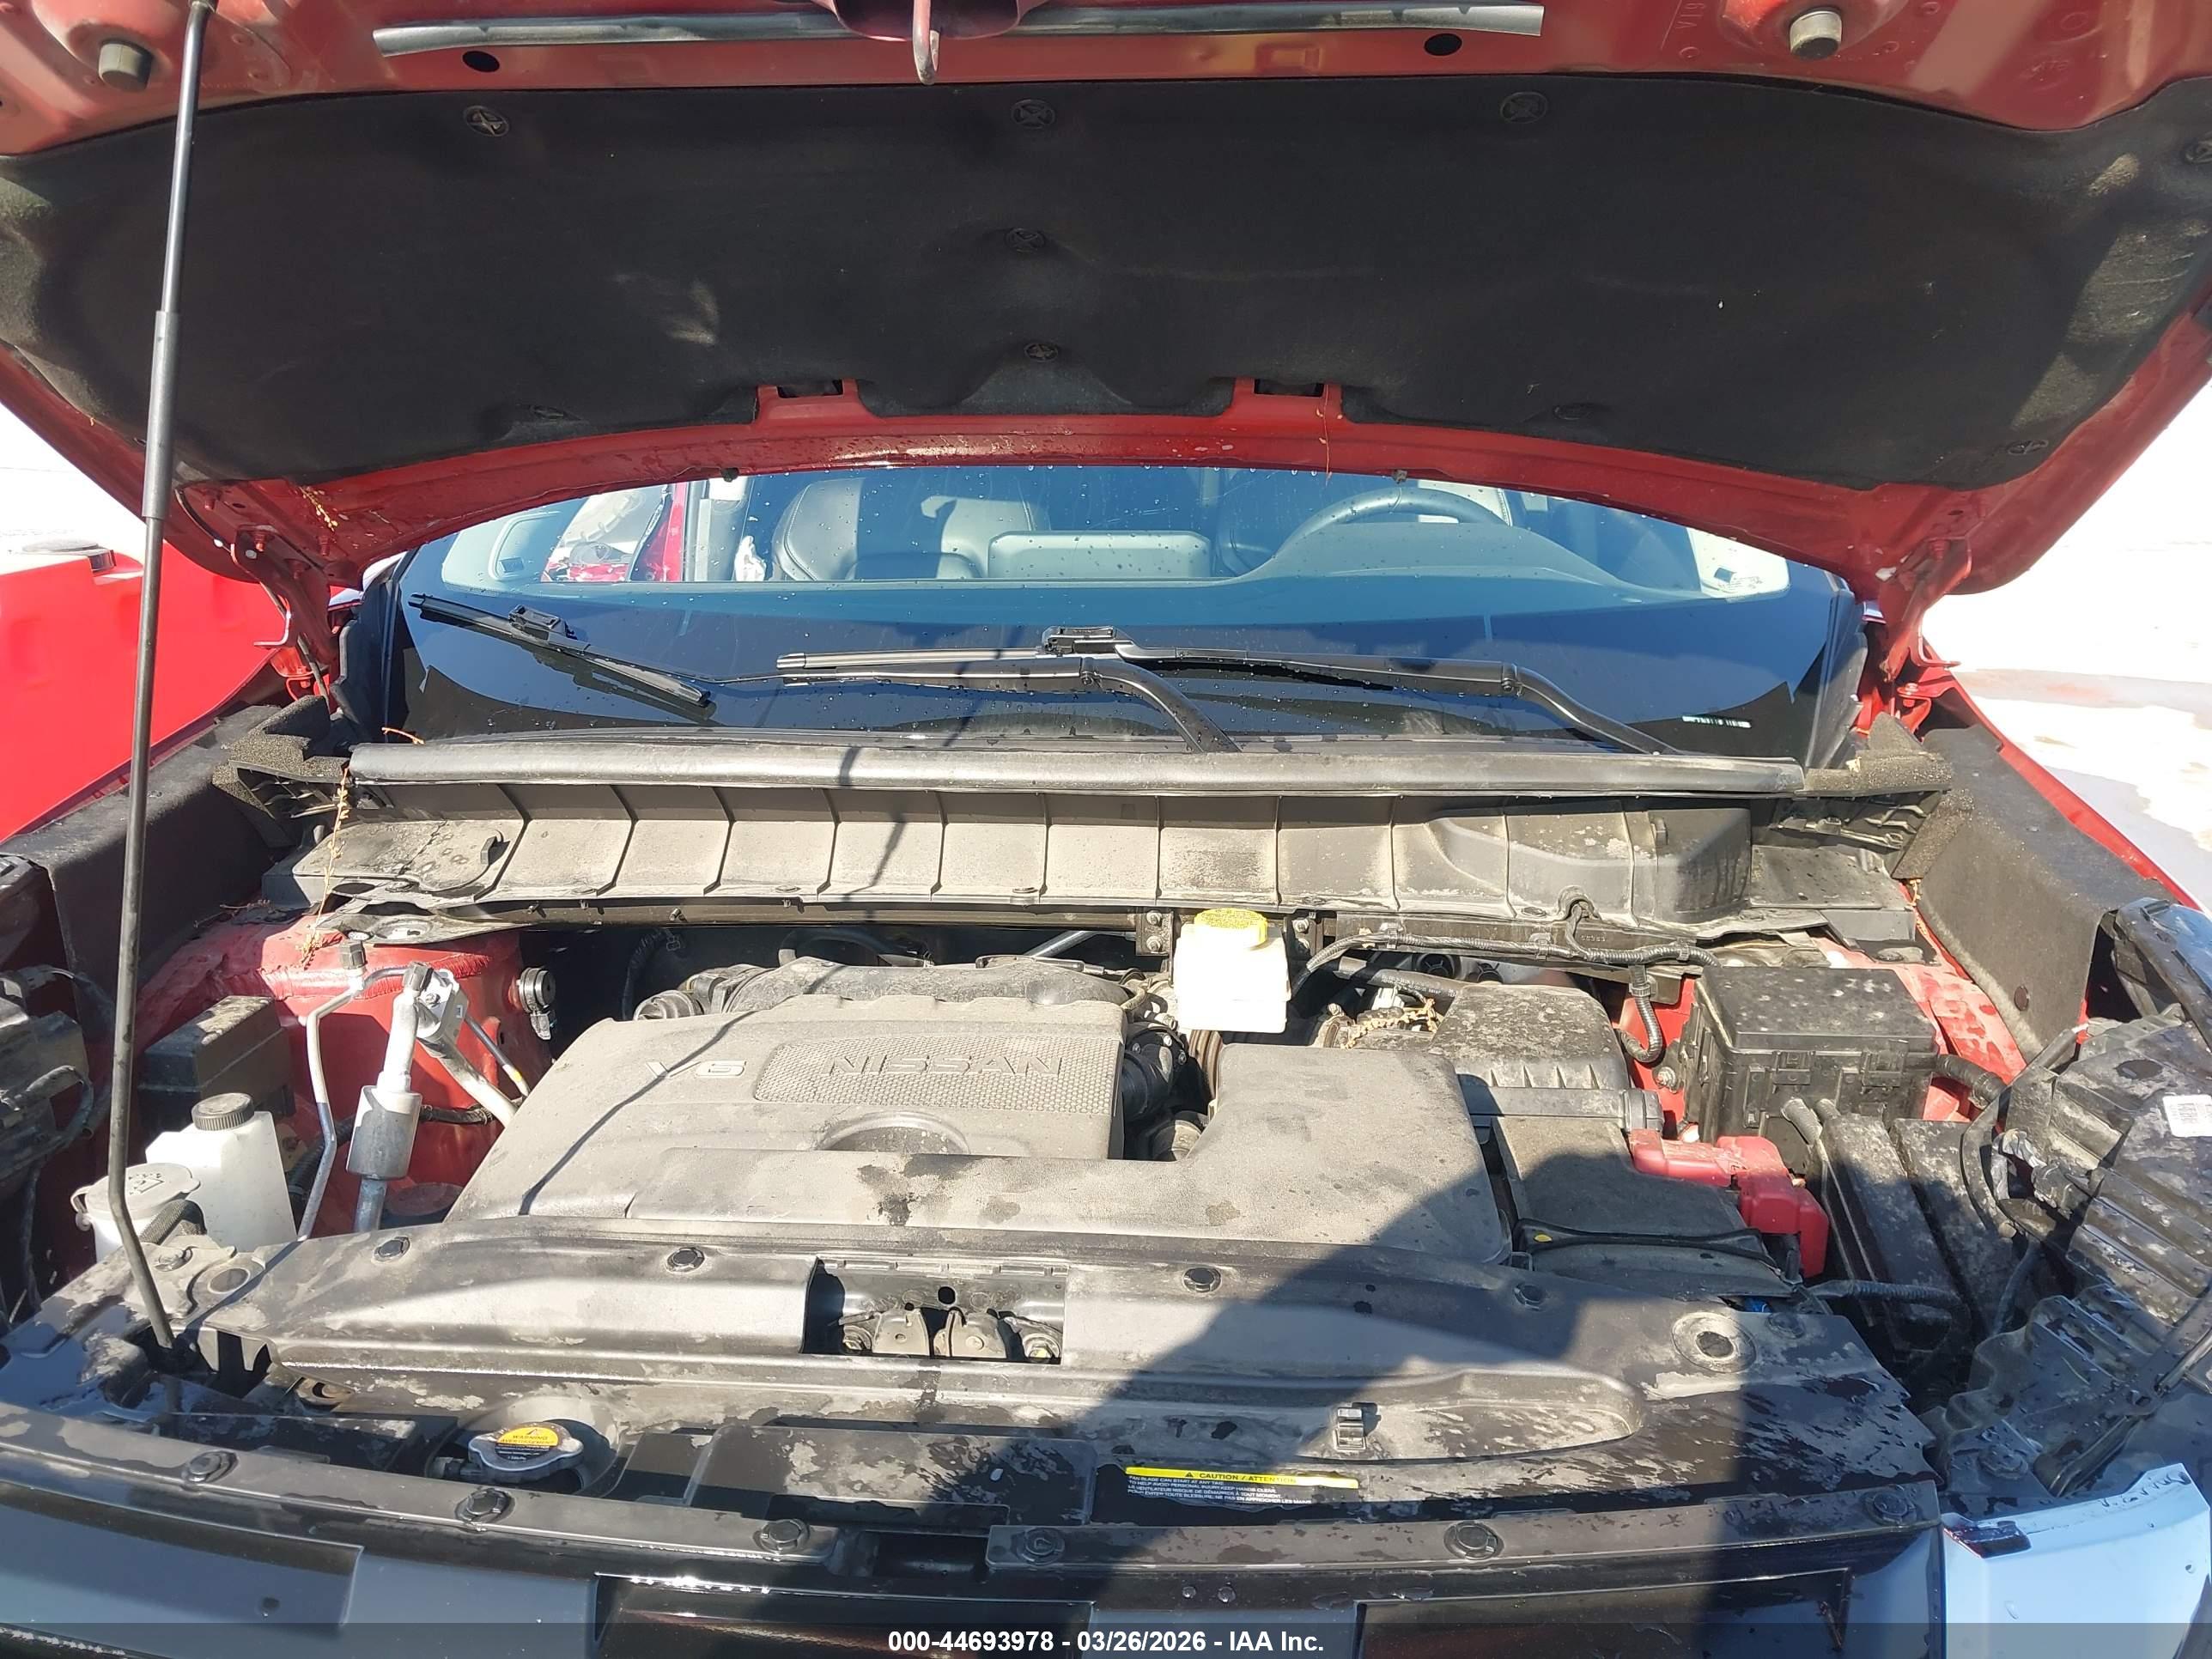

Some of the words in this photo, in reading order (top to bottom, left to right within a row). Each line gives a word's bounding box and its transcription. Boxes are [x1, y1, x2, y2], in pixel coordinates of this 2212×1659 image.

[645, 1060, 747, 1079] V6
[825, 1054, 1062, 1076] NISSAN
[1249, 1475, 1297, 1484] ATTENTION
